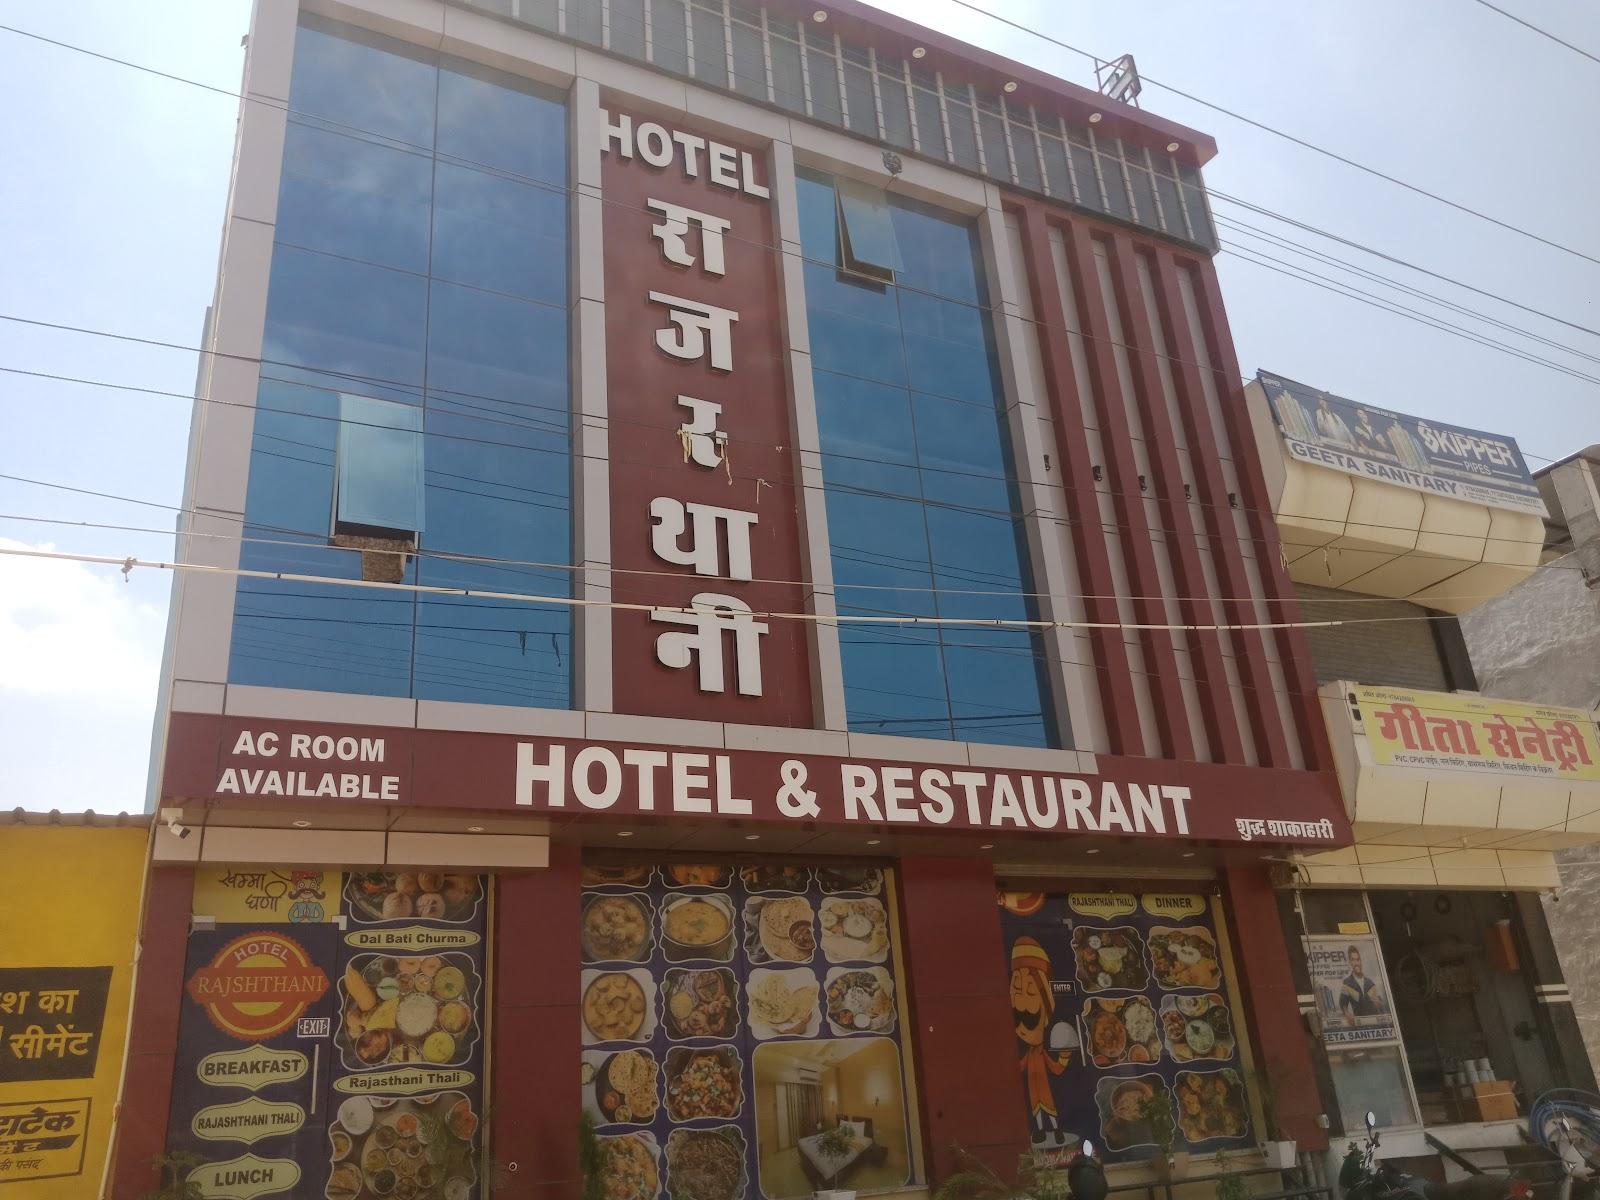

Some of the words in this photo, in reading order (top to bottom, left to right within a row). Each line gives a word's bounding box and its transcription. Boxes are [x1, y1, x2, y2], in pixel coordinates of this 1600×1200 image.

[600, 108, 770, 199] HOTEL
[1417, 421, 1518, 469] SKIPPER
[1291, 442, 1360, 471] GEETA
[1361, 459, 1458, 495] SANITARY
[1463, 460, 1492, 476] PIPES
[1375, 702, 1481, 756] गीता
[231, 730, 279, 757] AC
[289, 734, 385, 762] ROOM
[216, 767, 400, 800] AVAILABLE
[515, 742, 753, 815] HOTEL
[775, 759, 821, 819] &
[840, 763, 1192, 835] RESTAURANT
[1235, 818, 1266, 841] शुद्ध
[1266, 818, 1334, 839] शाकाहारी
[1156, 897, 1193, 908] DINNER
[360, 934, 381, 944] Dal
[385, 934, 412, 944] Bati
[416, 933, 466, 944] Churma
[234, 942, 289, 961] HOTEL
[198, 975, 324, 997] RAJSHTHANI
[1053, 983, 1072, 992] ENTER
[37, 989, 80, 1015] का
[303, 1020, 325, 1034] EXIT
[1347, 1029, 1394, 1041] SANITARY
[9, 1023, 93, 1060] सीमेंट
[204, 1059, 302, 1076] BREAKFAST
[349, 1074, 423, 1089] Rajasthani
[427, 1072, 460, 1083] Thali
[198, 1116, 268, 1130] RAJASHTHANI
[271, 1112, 300, 1125] THALI
[214, 1168, 274, 1187] LUNCH
